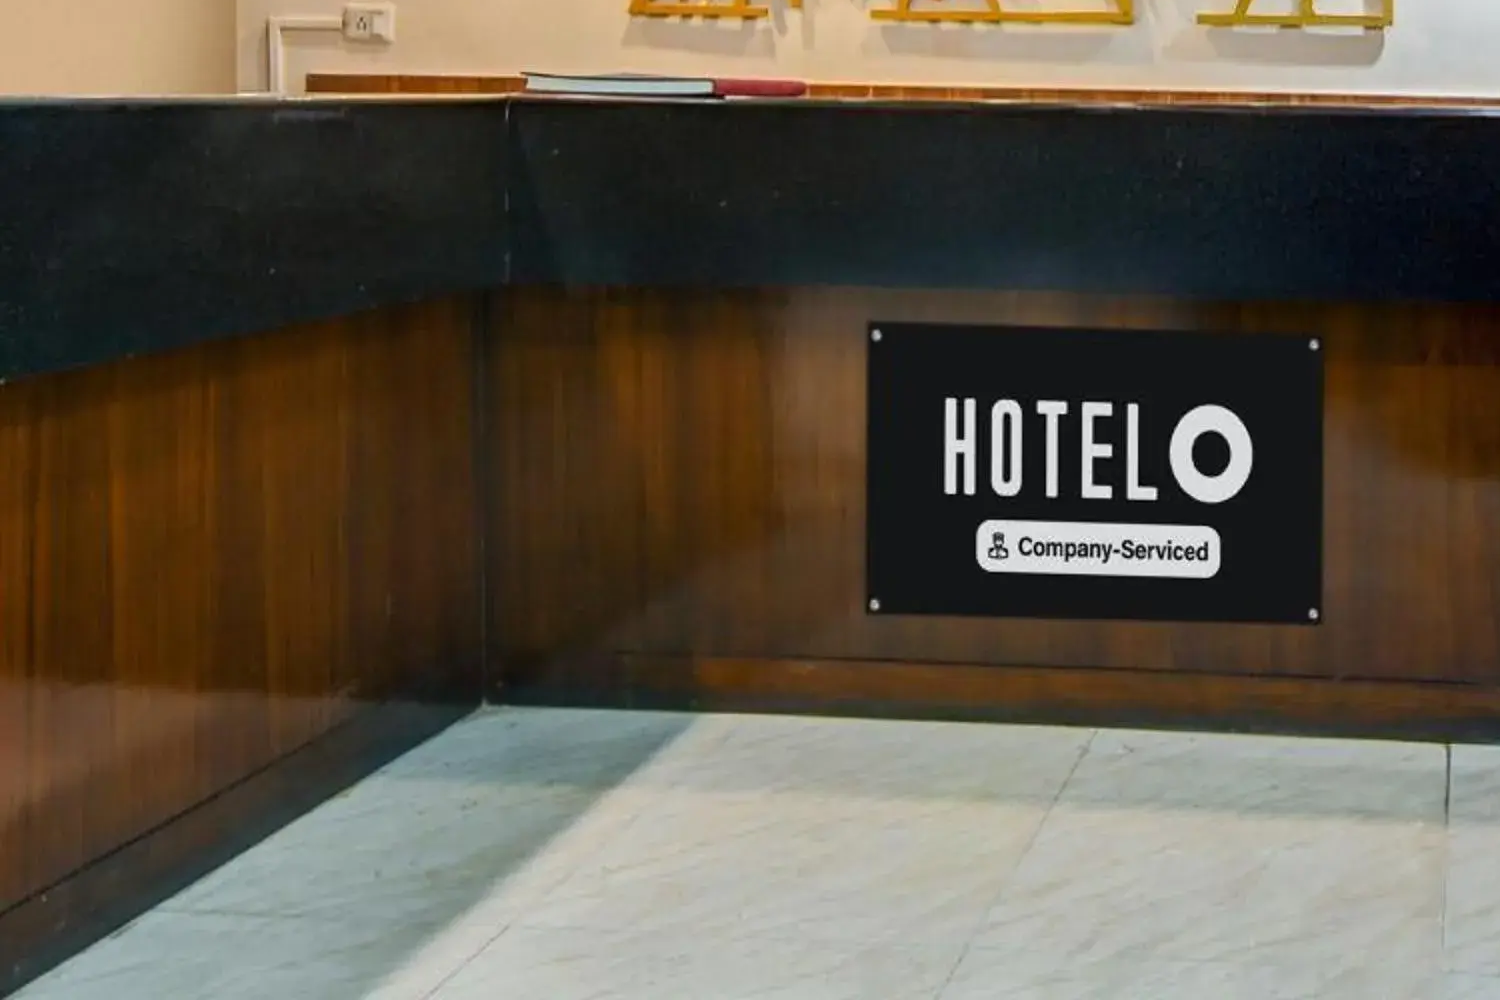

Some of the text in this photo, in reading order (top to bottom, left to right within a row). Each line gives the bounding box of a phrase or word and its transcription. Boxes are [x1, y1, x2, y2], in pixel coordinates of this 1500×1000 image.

[944, 397, 1253, 504] HOTEL O
[1018, 536, 1209, 564] Company-Serviced
